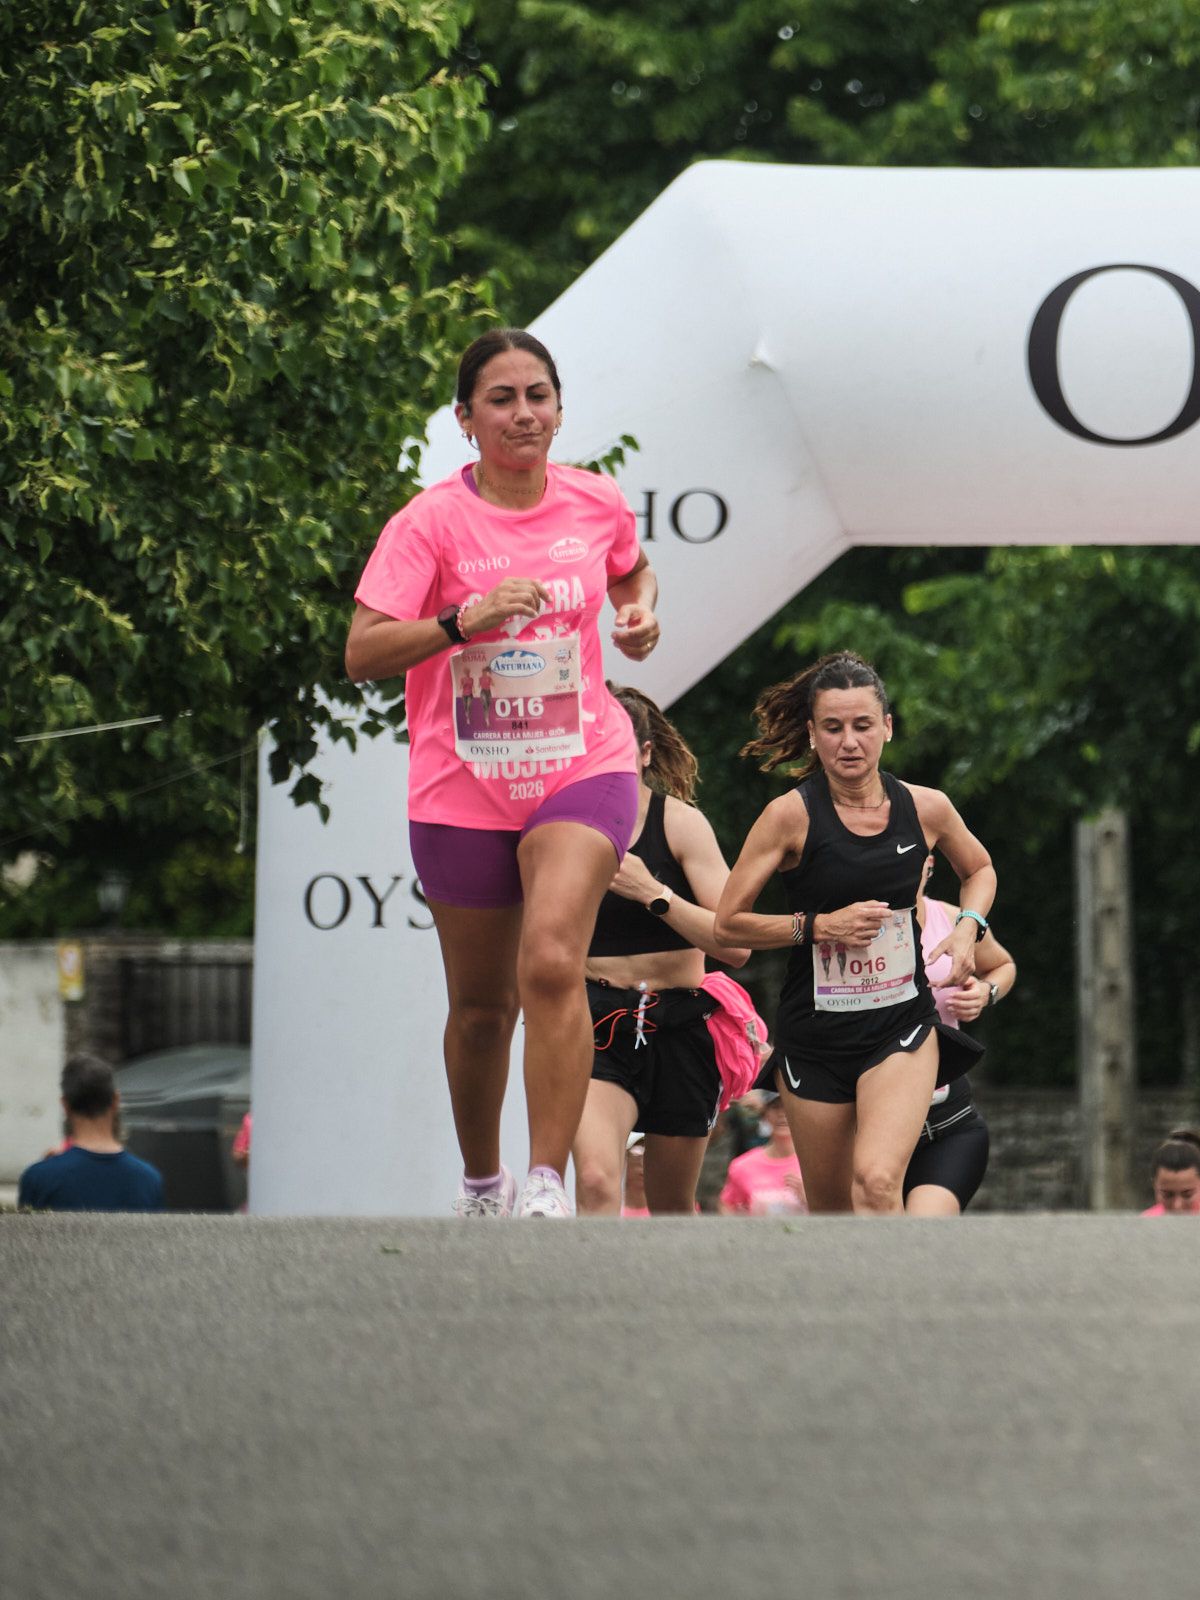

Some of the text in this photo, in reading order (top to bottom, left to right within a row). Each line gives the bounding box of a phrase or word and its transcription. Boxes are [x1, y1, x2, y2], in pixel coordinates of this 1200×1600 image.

[458, 556, 510, 574] OYSHO
[493, 660, 542, 671] ASTURIANA
[495, 696, 544, 717] 016
[511, 721, 528, 730] 841
[473, 732, 501, 740] CARRERA
[513, 731, 521, 739] LA
[522, 730, 544, 739] MUJER
[470, 746, 509, 756] OYSHO
[536, 744, 571, 753] Santander
[508, 780, 545, 801] 2026
[850, 957, 886, 974] 016
[861, 977, 879, 985] 2012
[827, 998, 861, 1006] OYSHO
